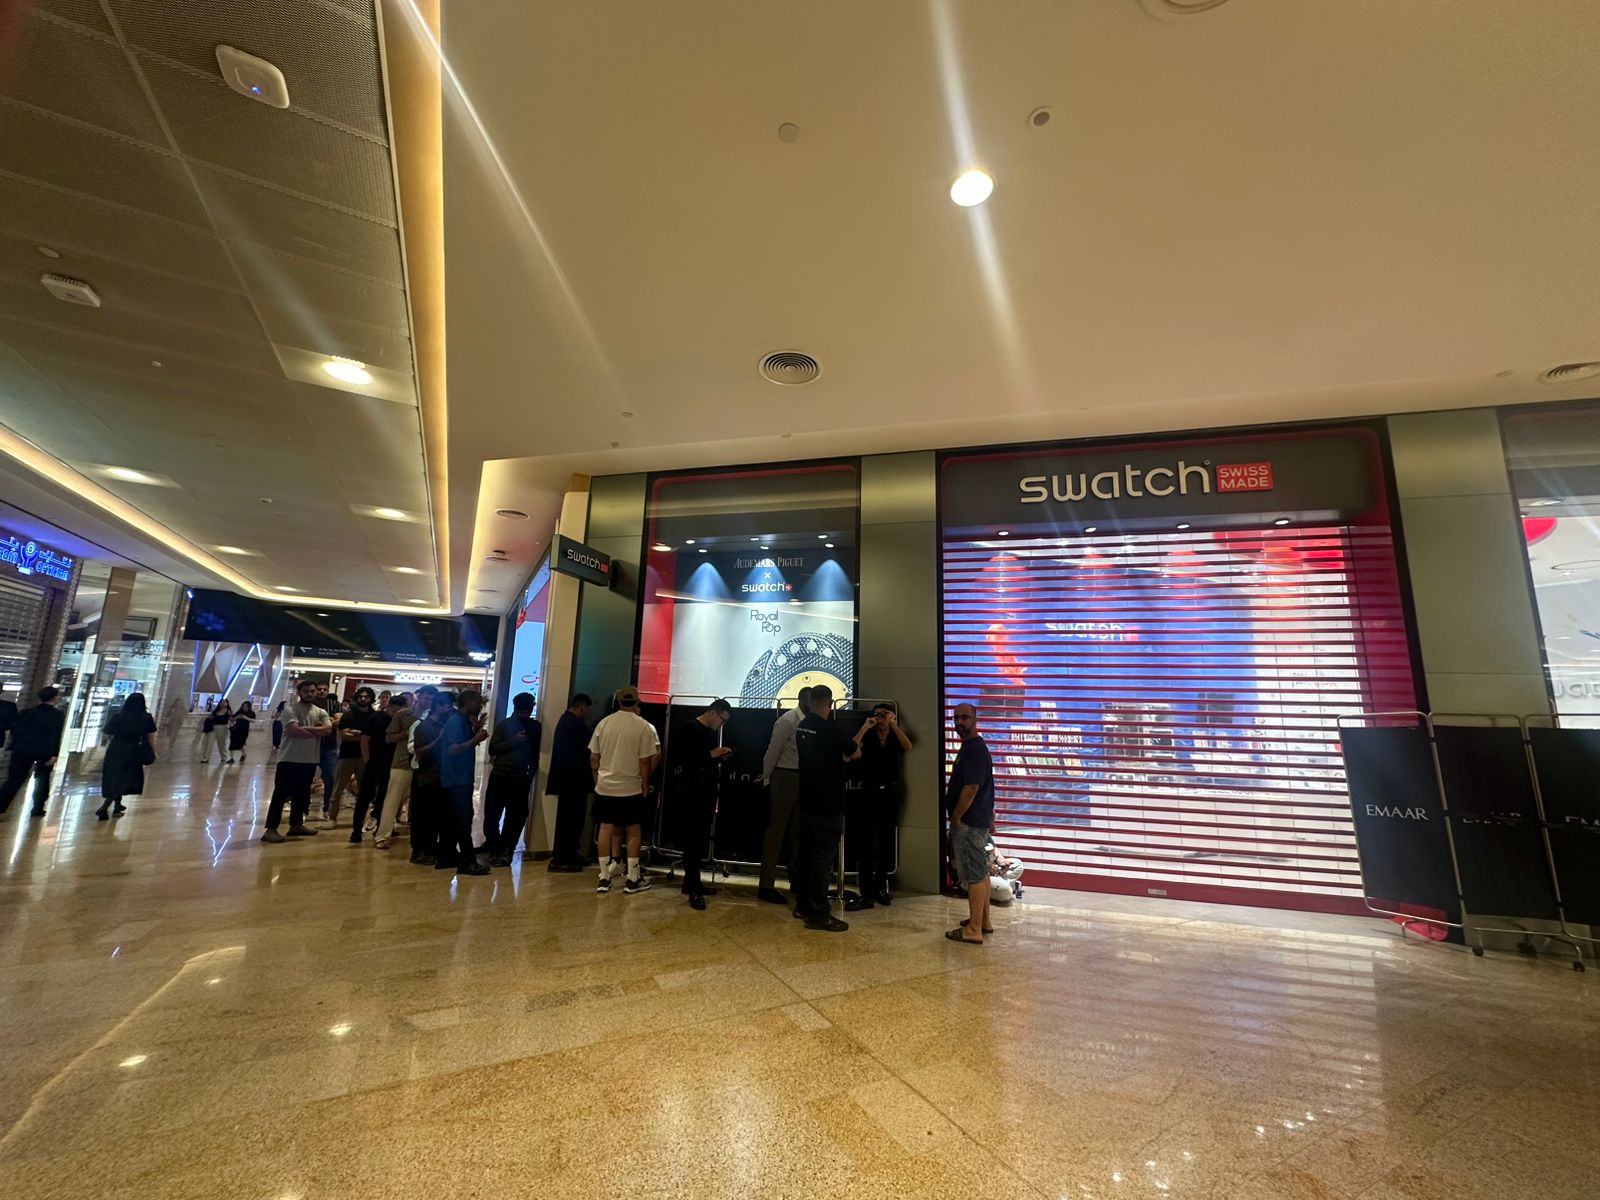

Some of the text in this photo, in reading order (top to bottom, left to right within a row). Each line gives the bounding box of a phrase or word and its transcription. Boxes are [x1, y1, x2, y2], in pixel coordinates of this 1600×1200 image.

[1220, 465, 1269, 478] SWISS
[1019, 460, 1210, 503] swatch
[1221, 476, 1270, 489] MADE
[567, 548, 601, 570] swatch
[734, 556, 804, 569] AUDEMARS PIGUET
[741, 581, 786, 593] swatch
[750, 608, 779, 622] Royal
[1365, 803, 1429, 821] EMAAR
